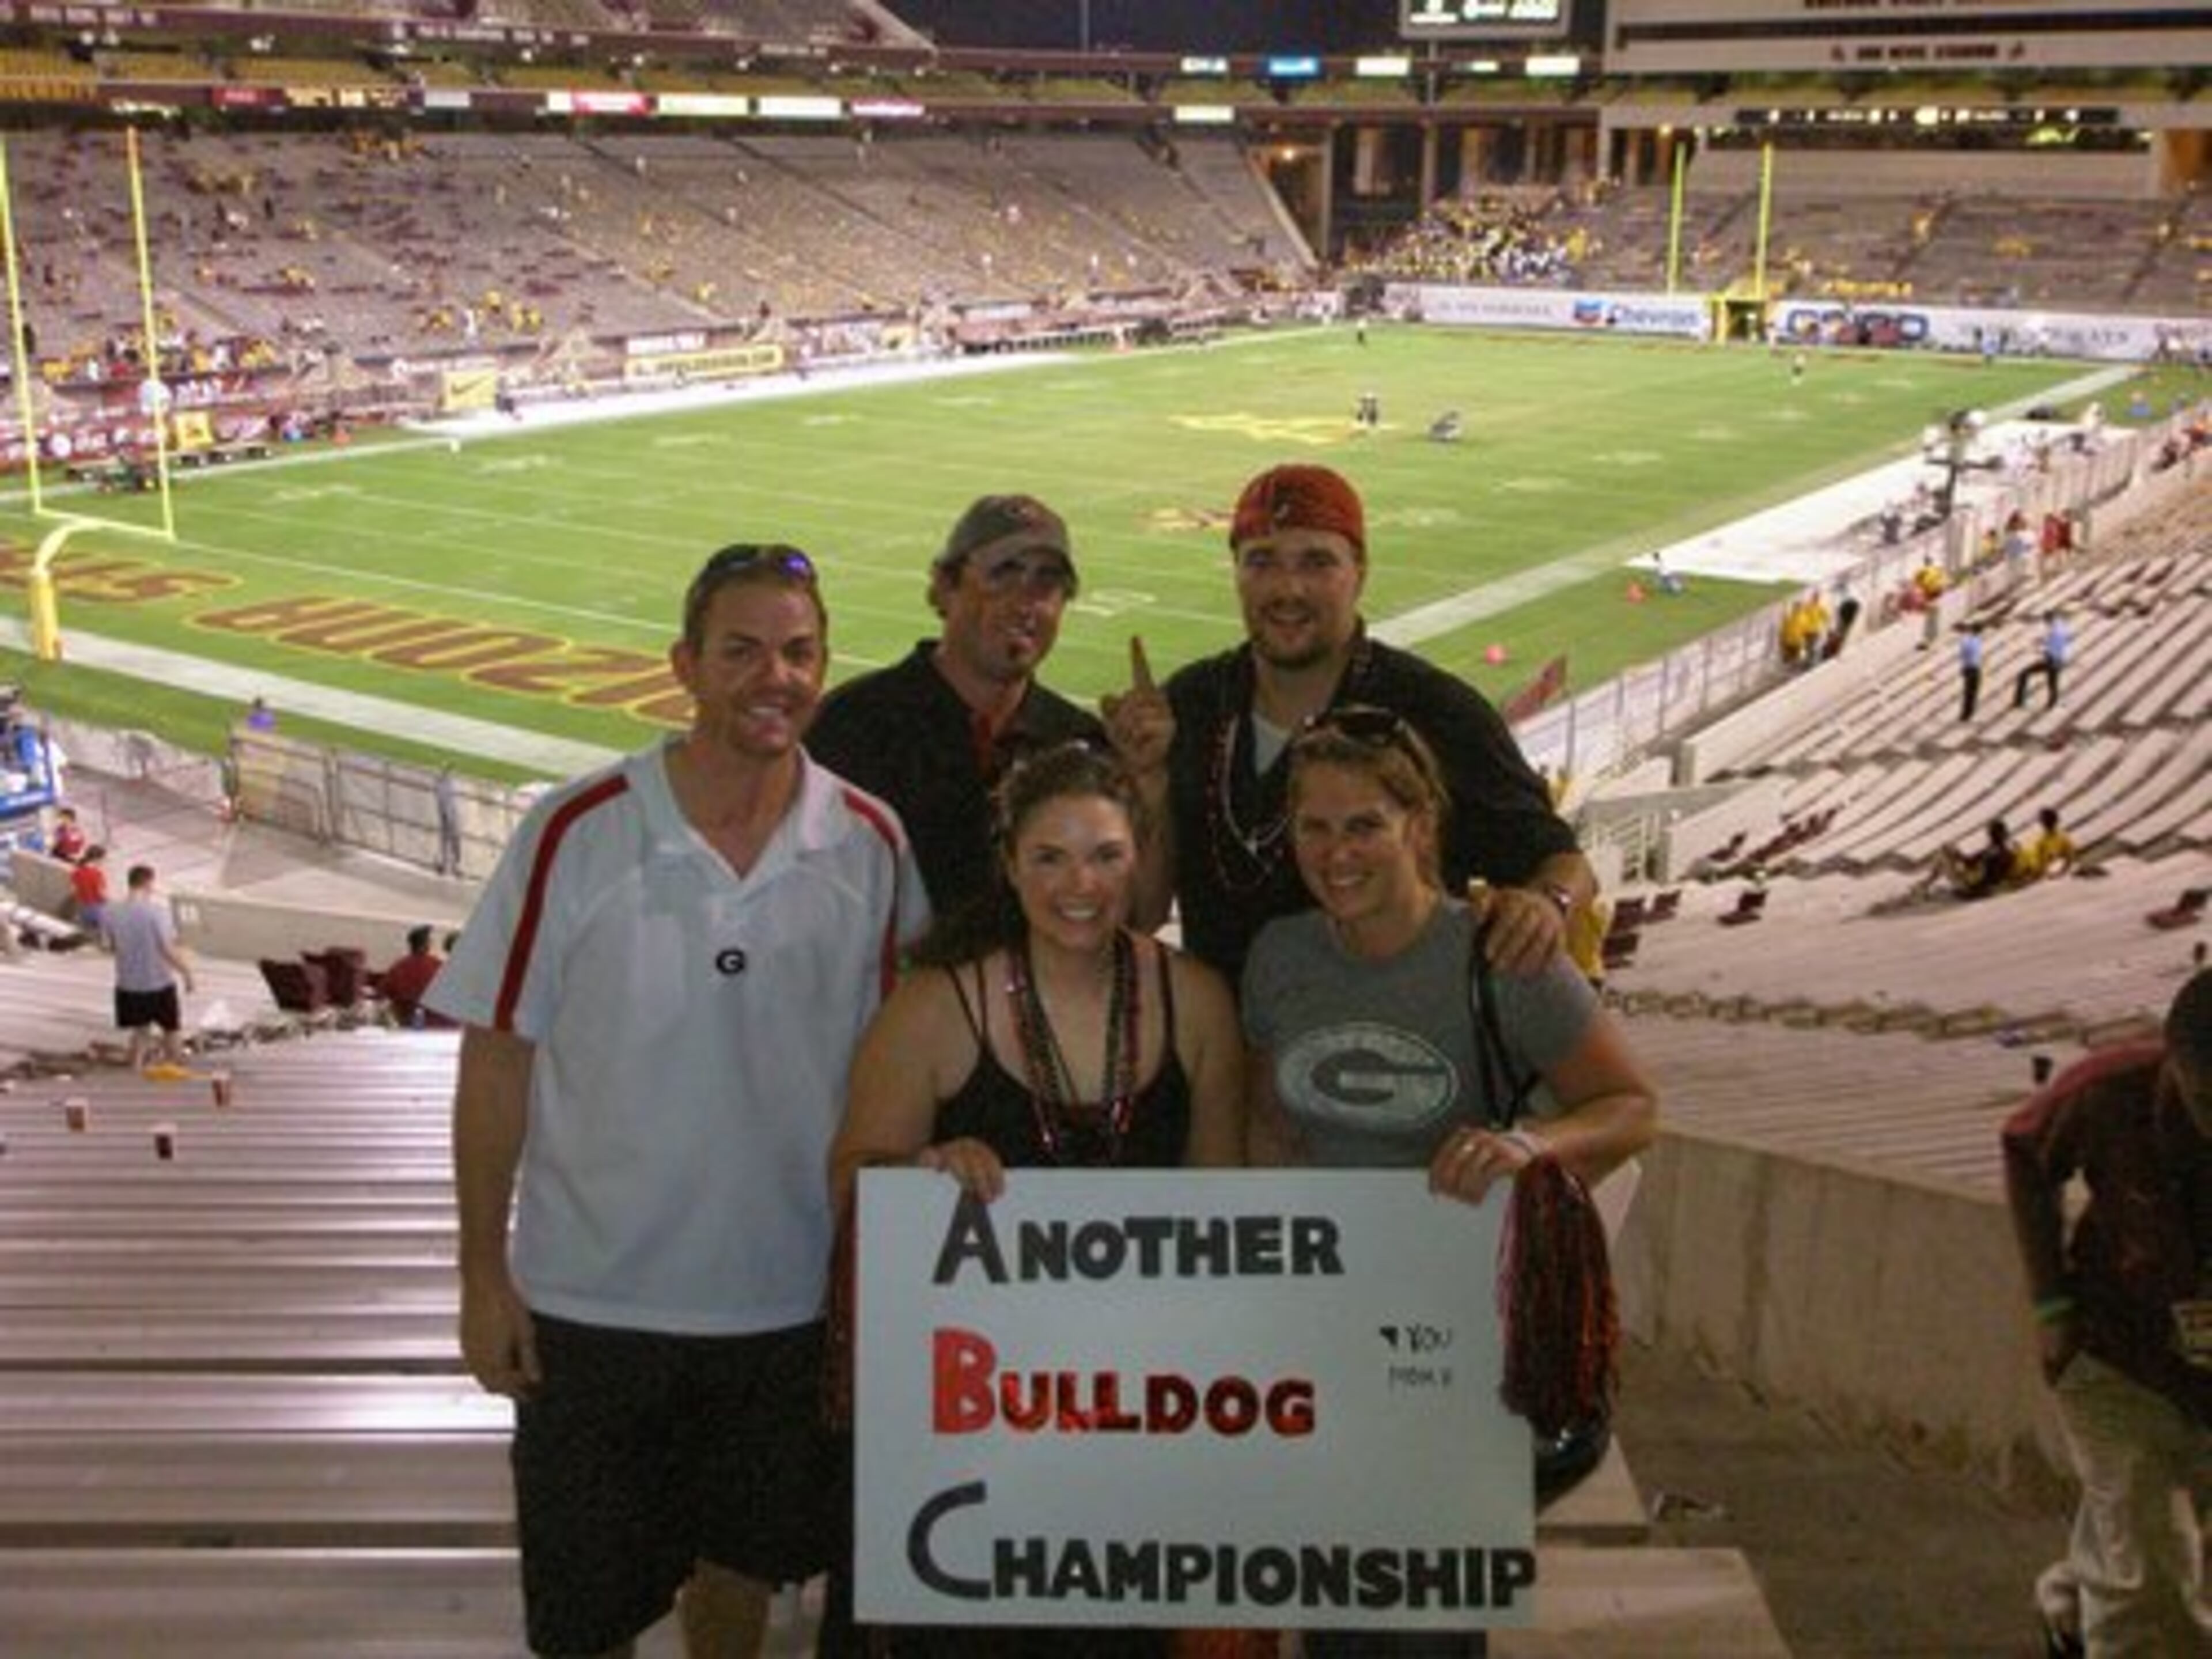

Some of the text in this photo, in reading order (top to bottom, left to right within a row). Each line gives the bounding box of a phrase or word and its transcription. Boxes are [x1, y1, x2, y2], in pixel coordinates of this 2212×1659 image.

[715, 948, 745, 975] G
[1277, 1024, 1460, 1130] G
[931, 1195, 1344, 1285] ANOTHER
[933, 1327, 1317, 1438] BULLDOG
[906, 1481, 1536, 1611] CHAMPIONSHIP
